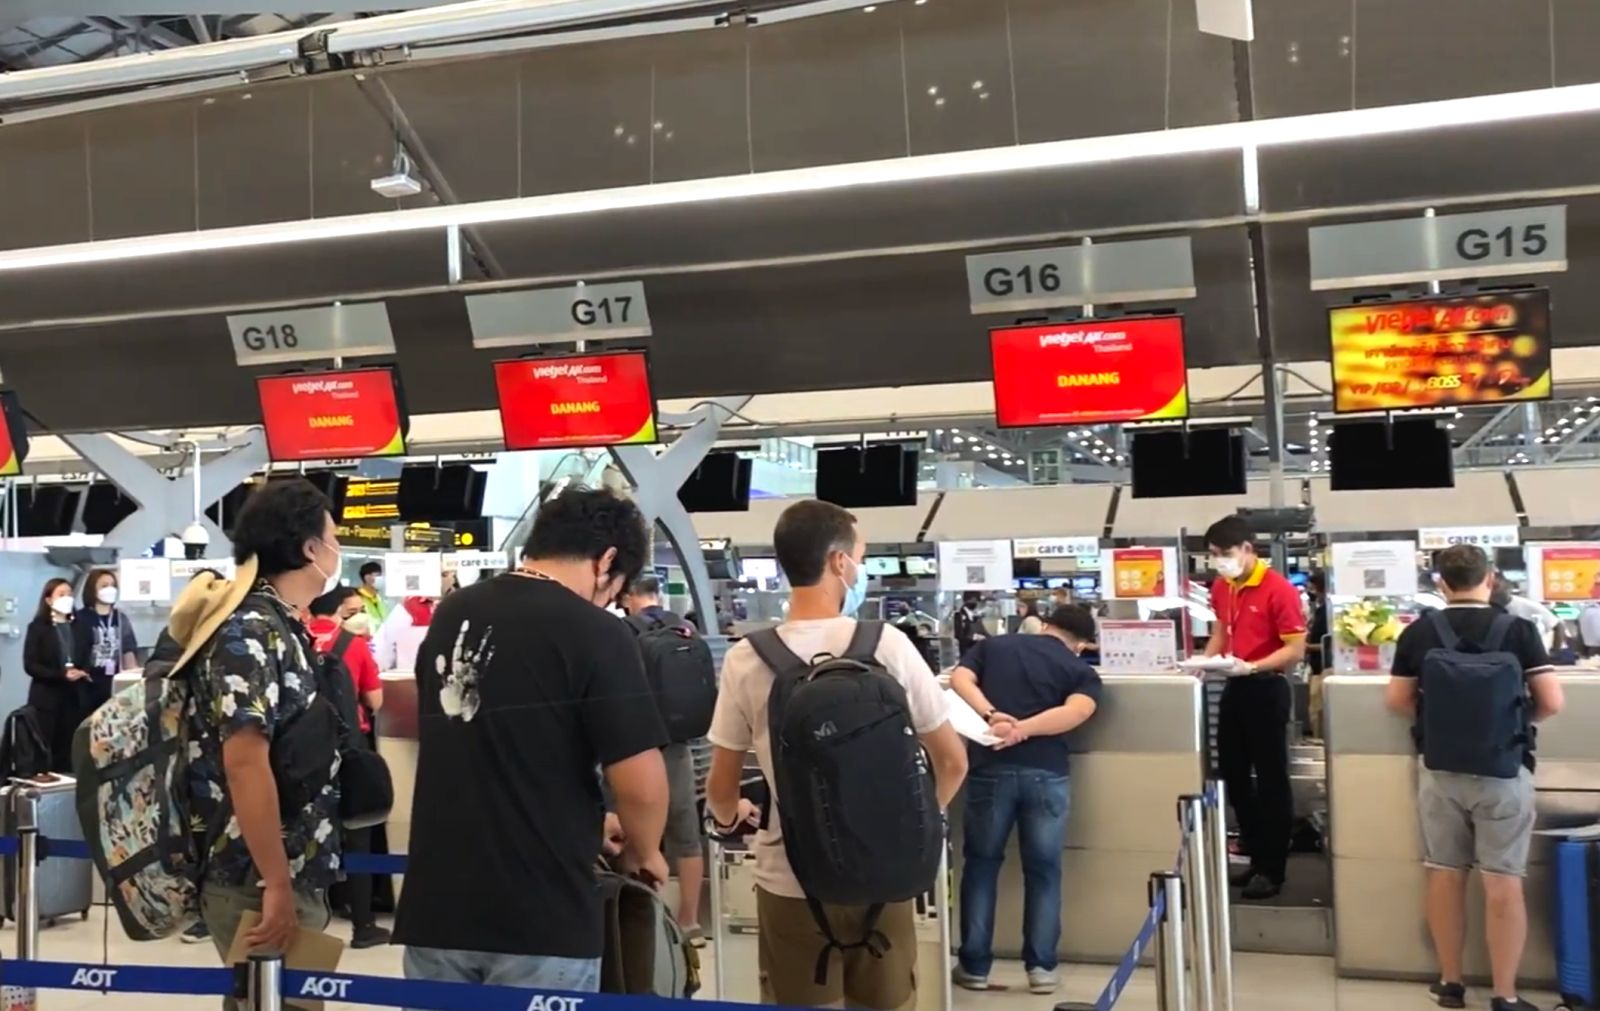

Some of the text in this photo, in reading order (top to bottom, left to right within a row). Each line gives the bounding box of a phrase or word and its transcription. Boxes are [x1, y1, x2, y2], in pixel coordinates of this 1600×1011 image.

[1456, 223, 1548, 260] G15
[983, 263, 1061, 296] G16
[571, 296, 632, 325] G17
[243, 324, 298, 351] G18
[1057, 372, 1120, 387] DANANG
[550, 401, 601, 415] DANANG
[308, 415, 354, 428] DANANG
[1447, 534, 1478, 546] care
[1037, 543, 1065, 555] care
[460, 558, 482, 567] care
[71, 968, 117, 987] AOT
[300, 977, 353, 998] AOT
[526, 995, 584, 1011] AOT
